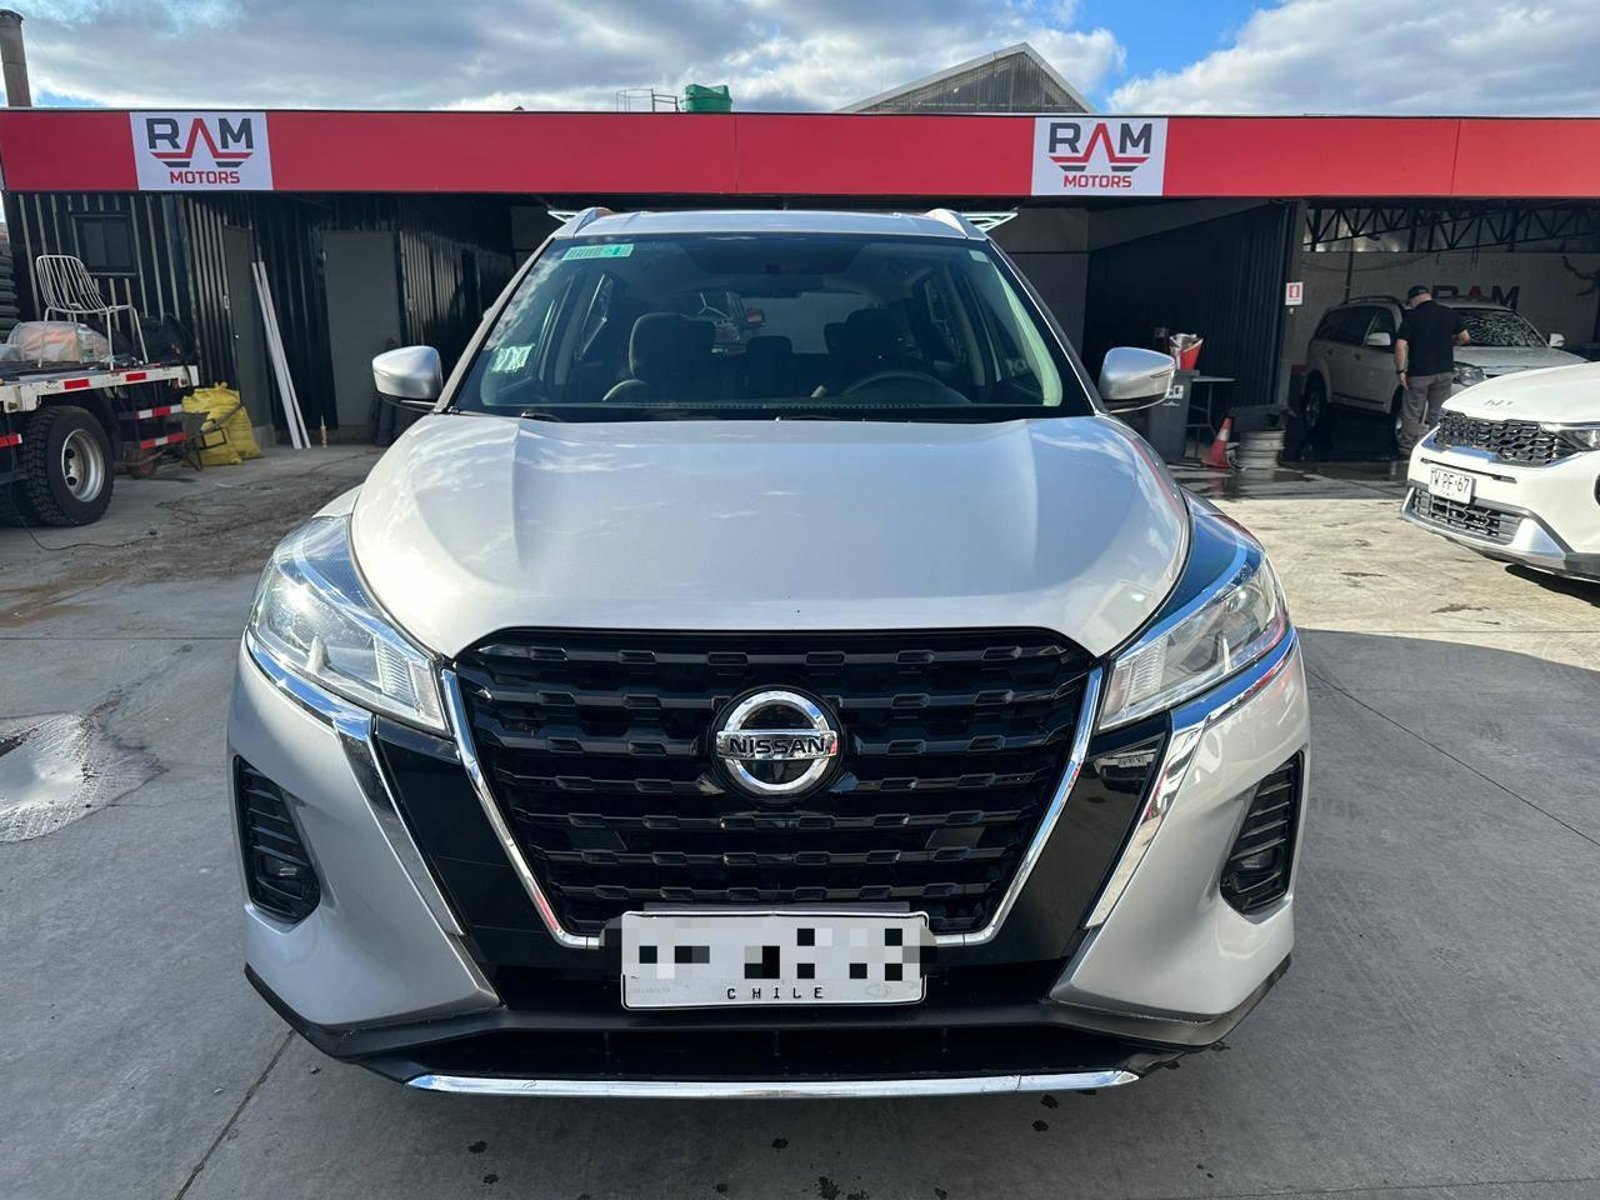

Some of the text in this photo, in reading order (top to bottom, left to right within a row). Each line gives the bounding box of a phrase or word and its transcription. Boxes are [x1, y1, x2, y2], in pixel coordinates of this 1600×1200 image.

[146, 118, 254, 158] RAM
[1049, 122, 1153, 163] RAM
[169, 171, 240, 184] MOTORS
[1063, 175, 1132, 188] MOTORS
[729, 738, 824, 754] NISSAN
[726, 987, 823, 1000] CHILE
